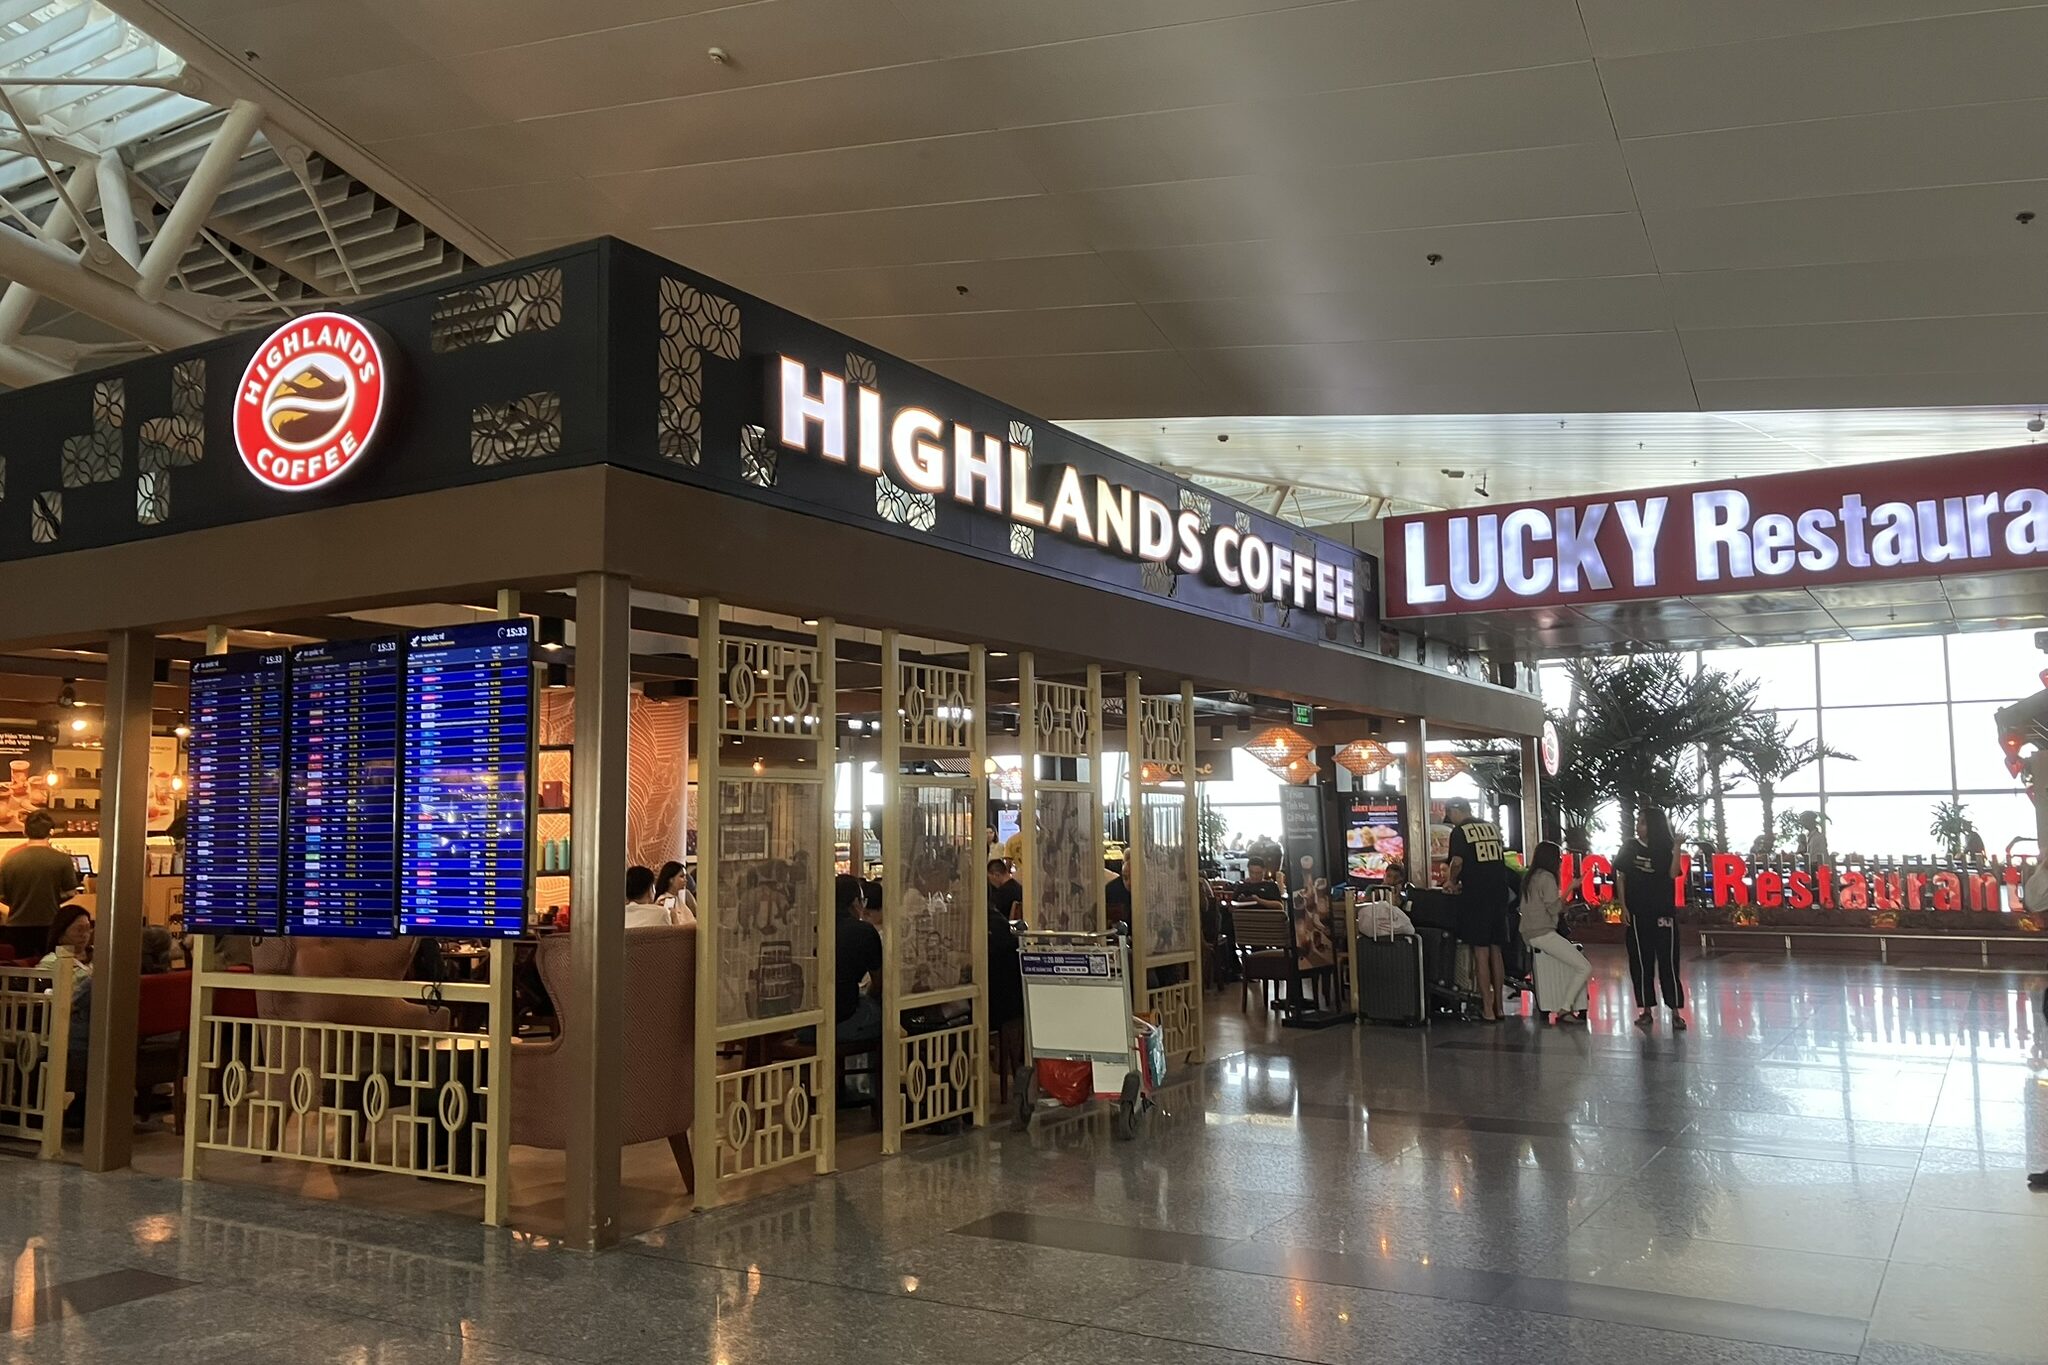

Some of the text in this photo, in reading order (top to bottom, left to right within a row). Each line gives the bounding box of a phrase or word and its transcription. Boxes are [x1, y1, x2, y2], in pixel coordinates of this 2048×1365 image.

[244, 325, 375, 405] HIGHLANDS
[256, 431, 358, 480] COFFEE
[780, 355, 1355, 620] HIGHLANDS COFFEE
[1404, 487, 2048, 605] LUCKY Restaura
[377, 642, 396, 652] 15:33
[506, 626, 528, 637] 15:33
